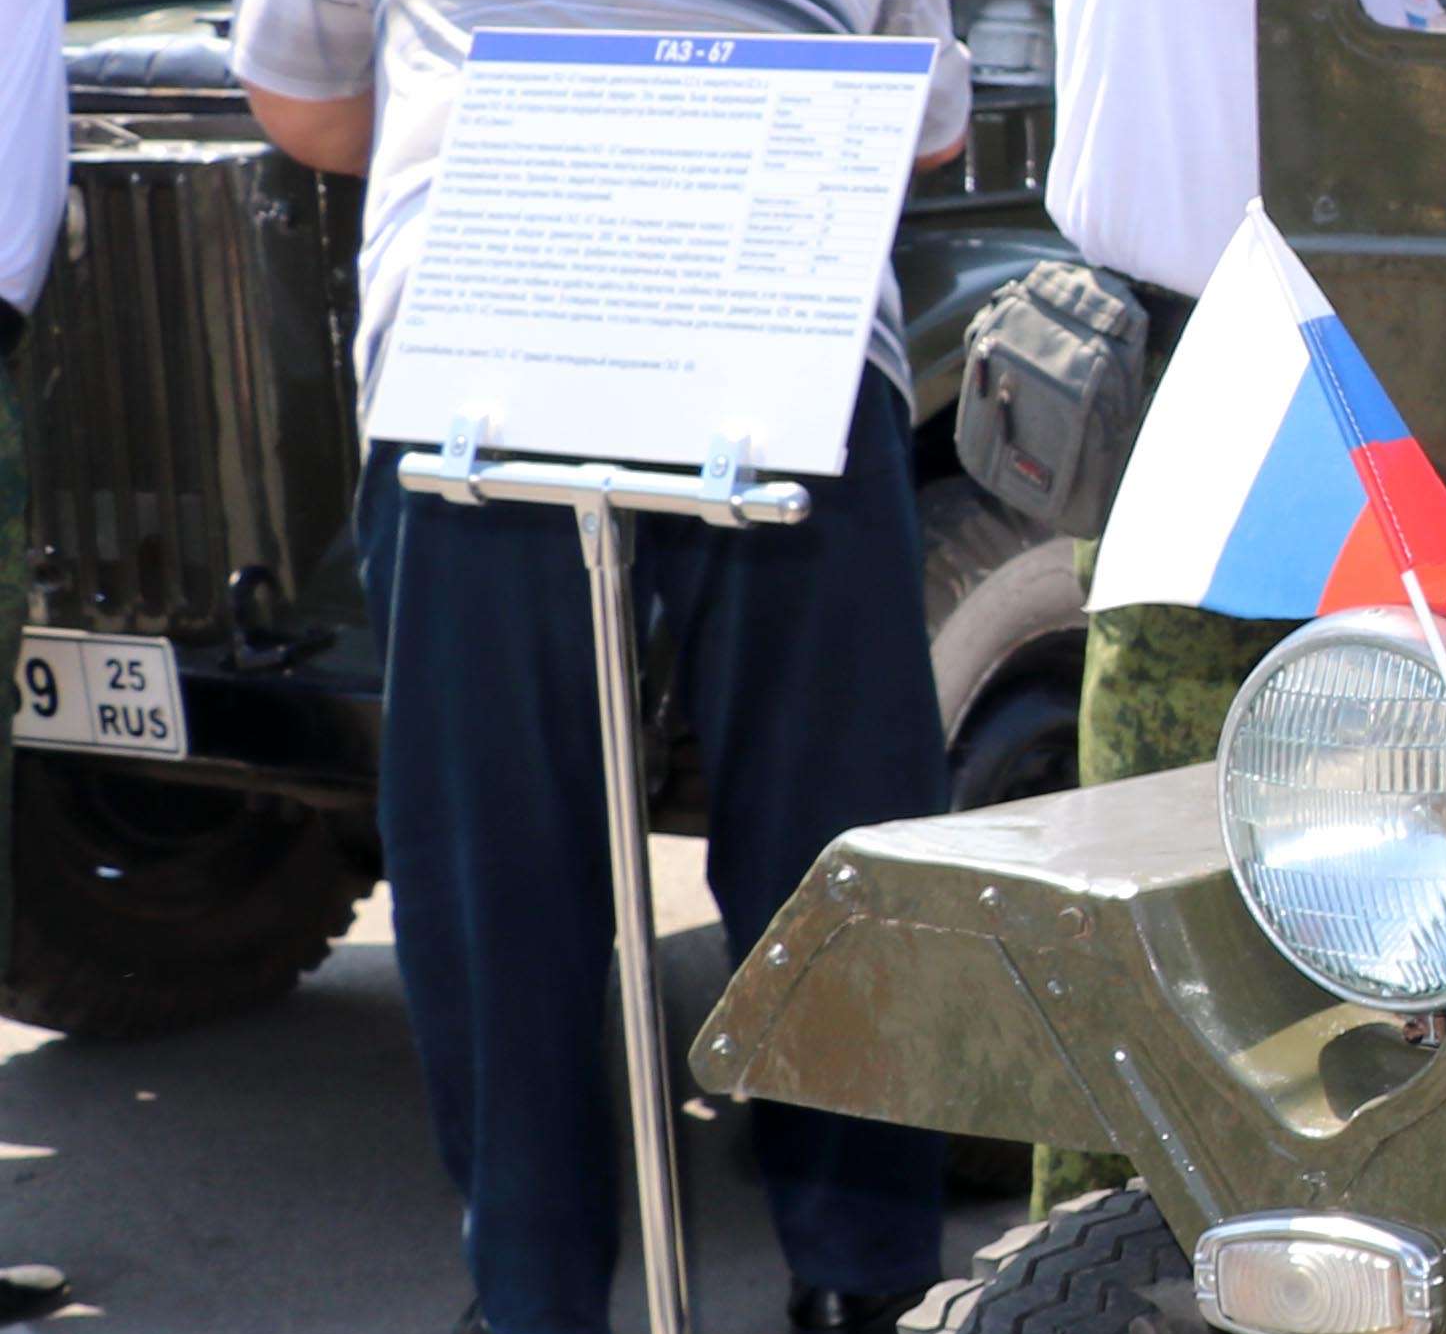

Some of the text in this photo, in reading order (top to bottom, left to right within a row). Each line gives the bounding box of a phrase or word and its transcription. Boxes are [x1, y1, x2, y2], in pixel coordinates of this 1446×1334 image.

[655, 39, 693, 62] ГАЗ
[707, 40, 736, 63] 67
[26, 657, 146, 718] 9 25
[98, 704, 168, 740] RUS
